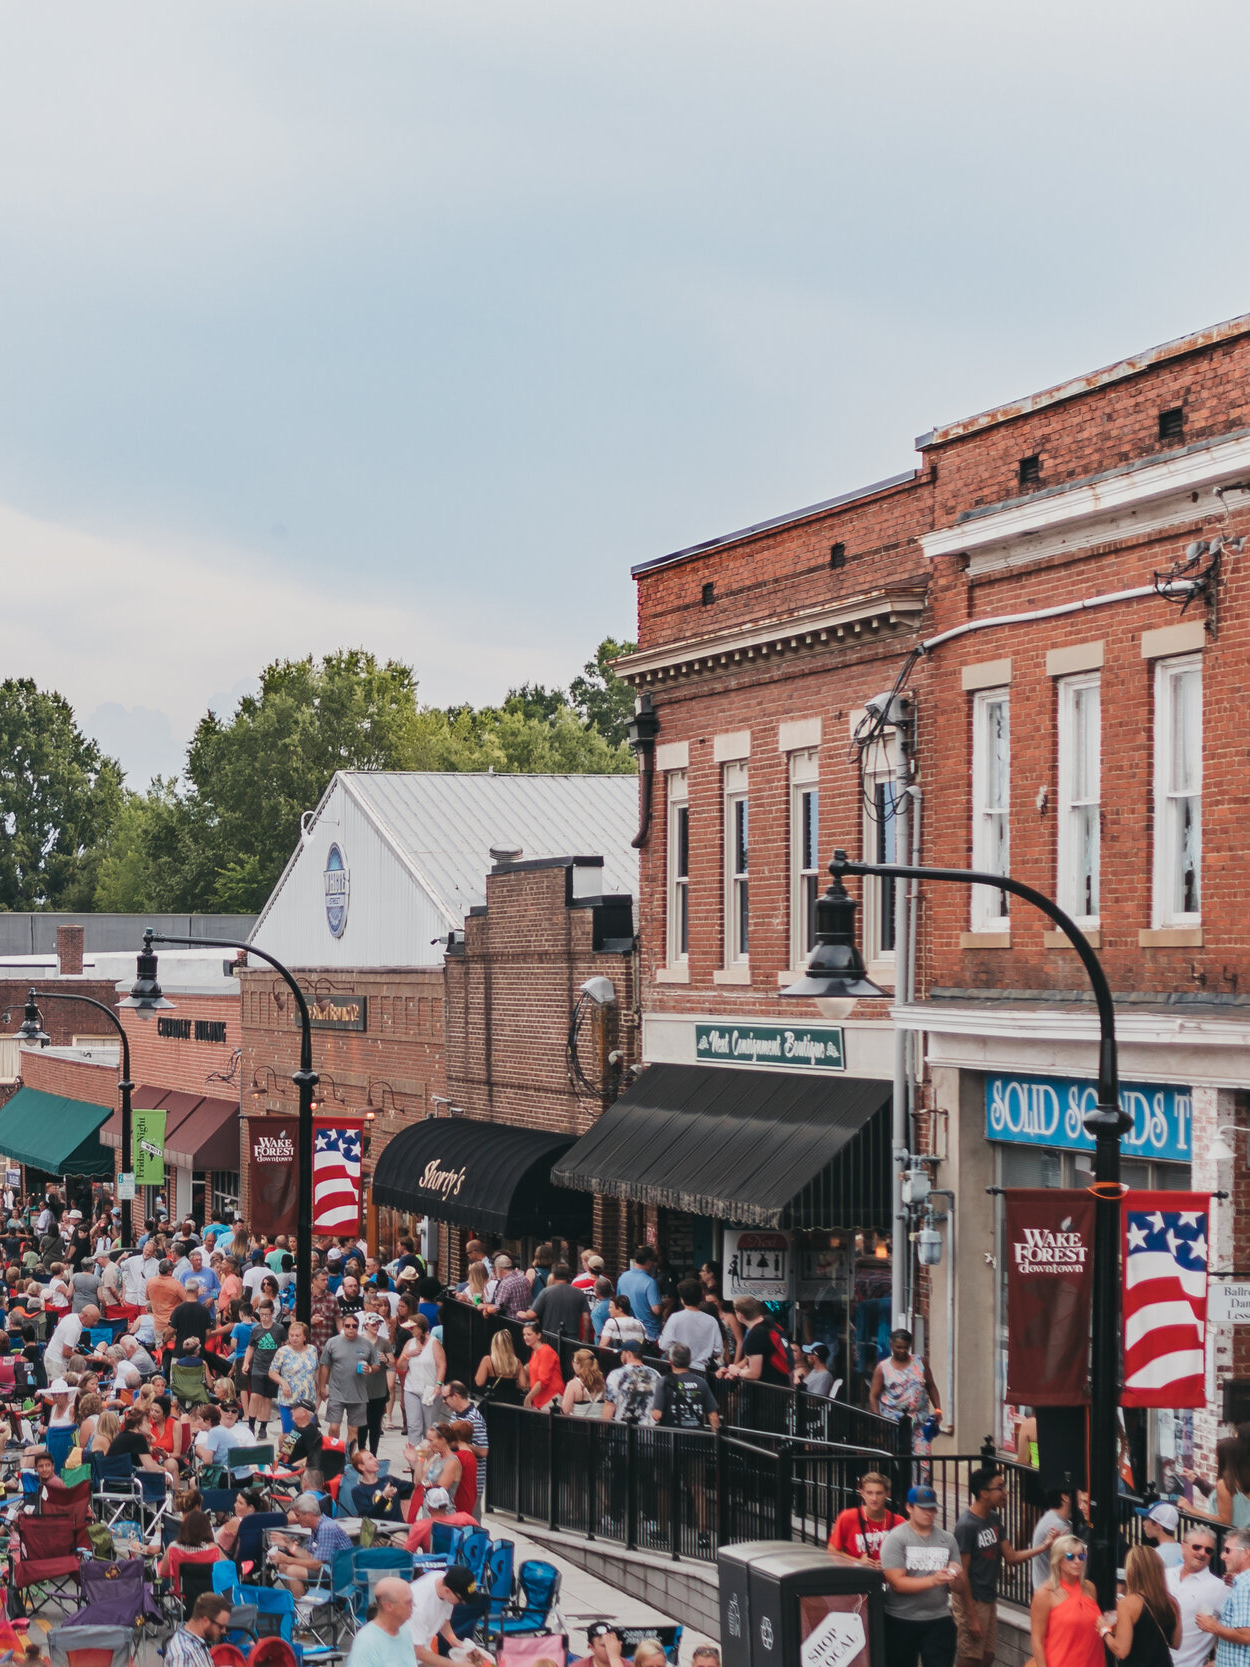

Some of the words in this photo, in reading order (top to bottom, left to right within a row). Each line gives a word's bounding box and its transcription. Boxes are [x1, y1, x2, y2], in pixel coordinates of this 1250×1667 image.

[708, 1030, 730, 1053] Next
[731, 1030, 782, 1062] Consignment
[784, 1031, 825, 1065] Boutique
[990, 1080, 1060, 1137] SOLID
[136, 1118, 148, 1143] Night
[254, 1145, 295, 1157] FOREST
[259, 1137, 293, 1149] WAKE
[256, 1154, 293, 1163] downtown
[418, 1158, 467, 1201] Shorty's
[1022, 1228, 1083, 1249] WAKE
[1013, 1242, 1089, 1264] FOREST
[1018, 1257, 1084, 1274] downtown
[808, 1628, 838, 1664] SHOP
[818, 1634, 859, 1667] OCAL
